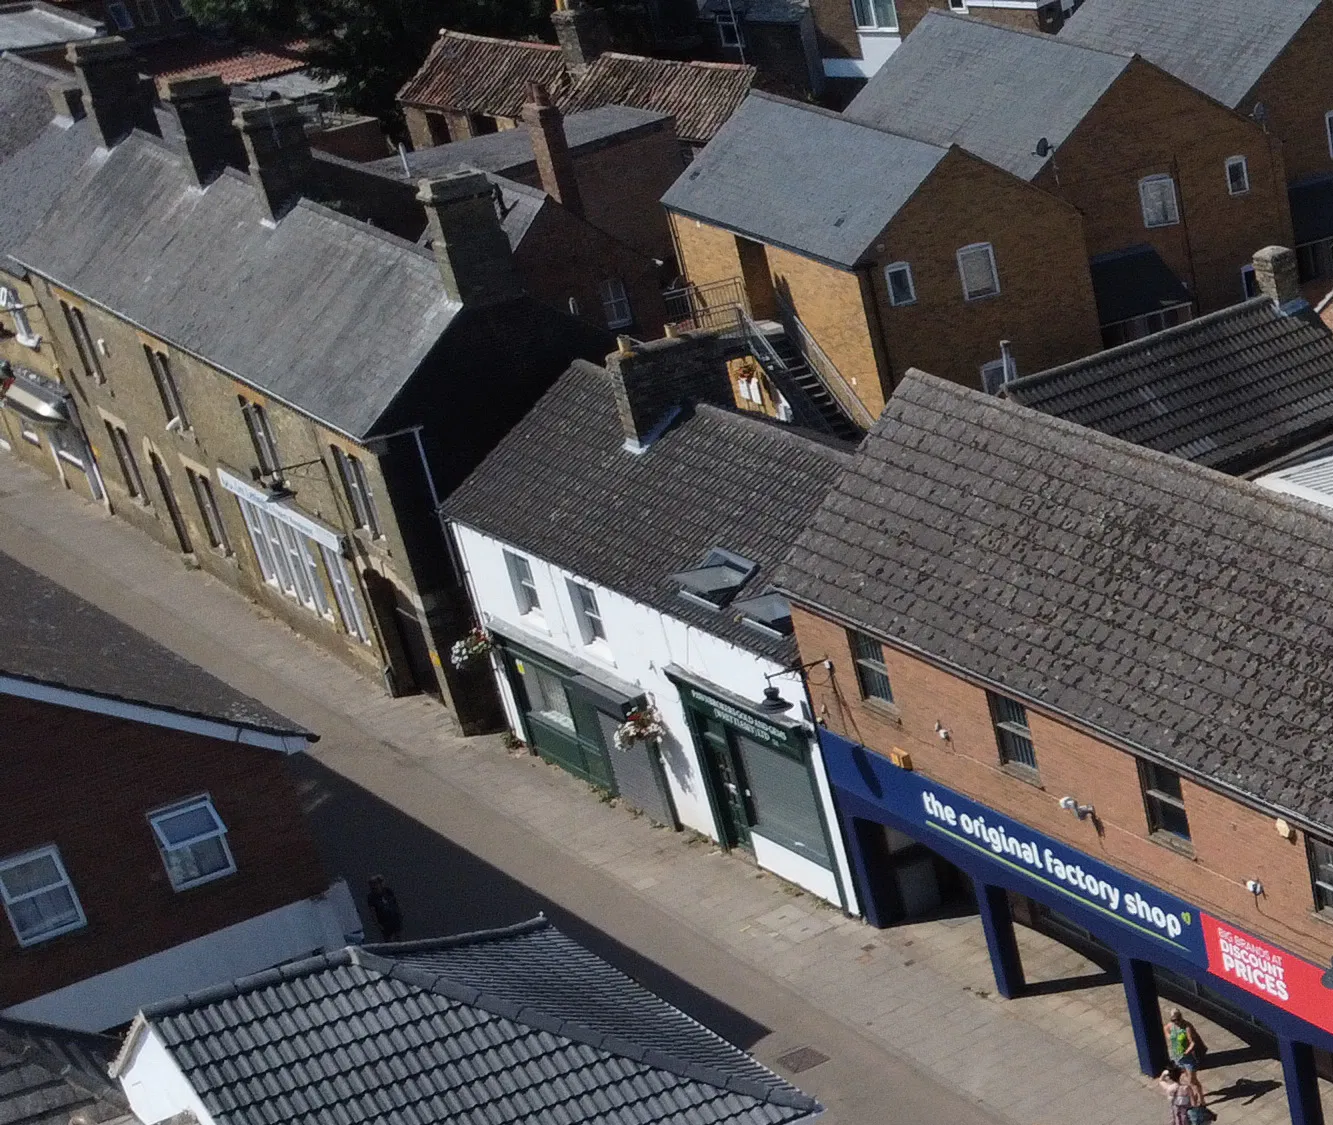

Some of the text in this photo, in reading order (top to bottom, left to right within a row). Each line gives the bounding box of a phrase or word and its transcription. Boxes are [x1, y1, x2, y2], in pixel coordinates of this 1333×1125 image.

[922, 790, 1182, 938] the original factory shop
[1219, 939, 1285, 981] DISCOUNT
[1222, 953, 1290, 1001] PRICES
